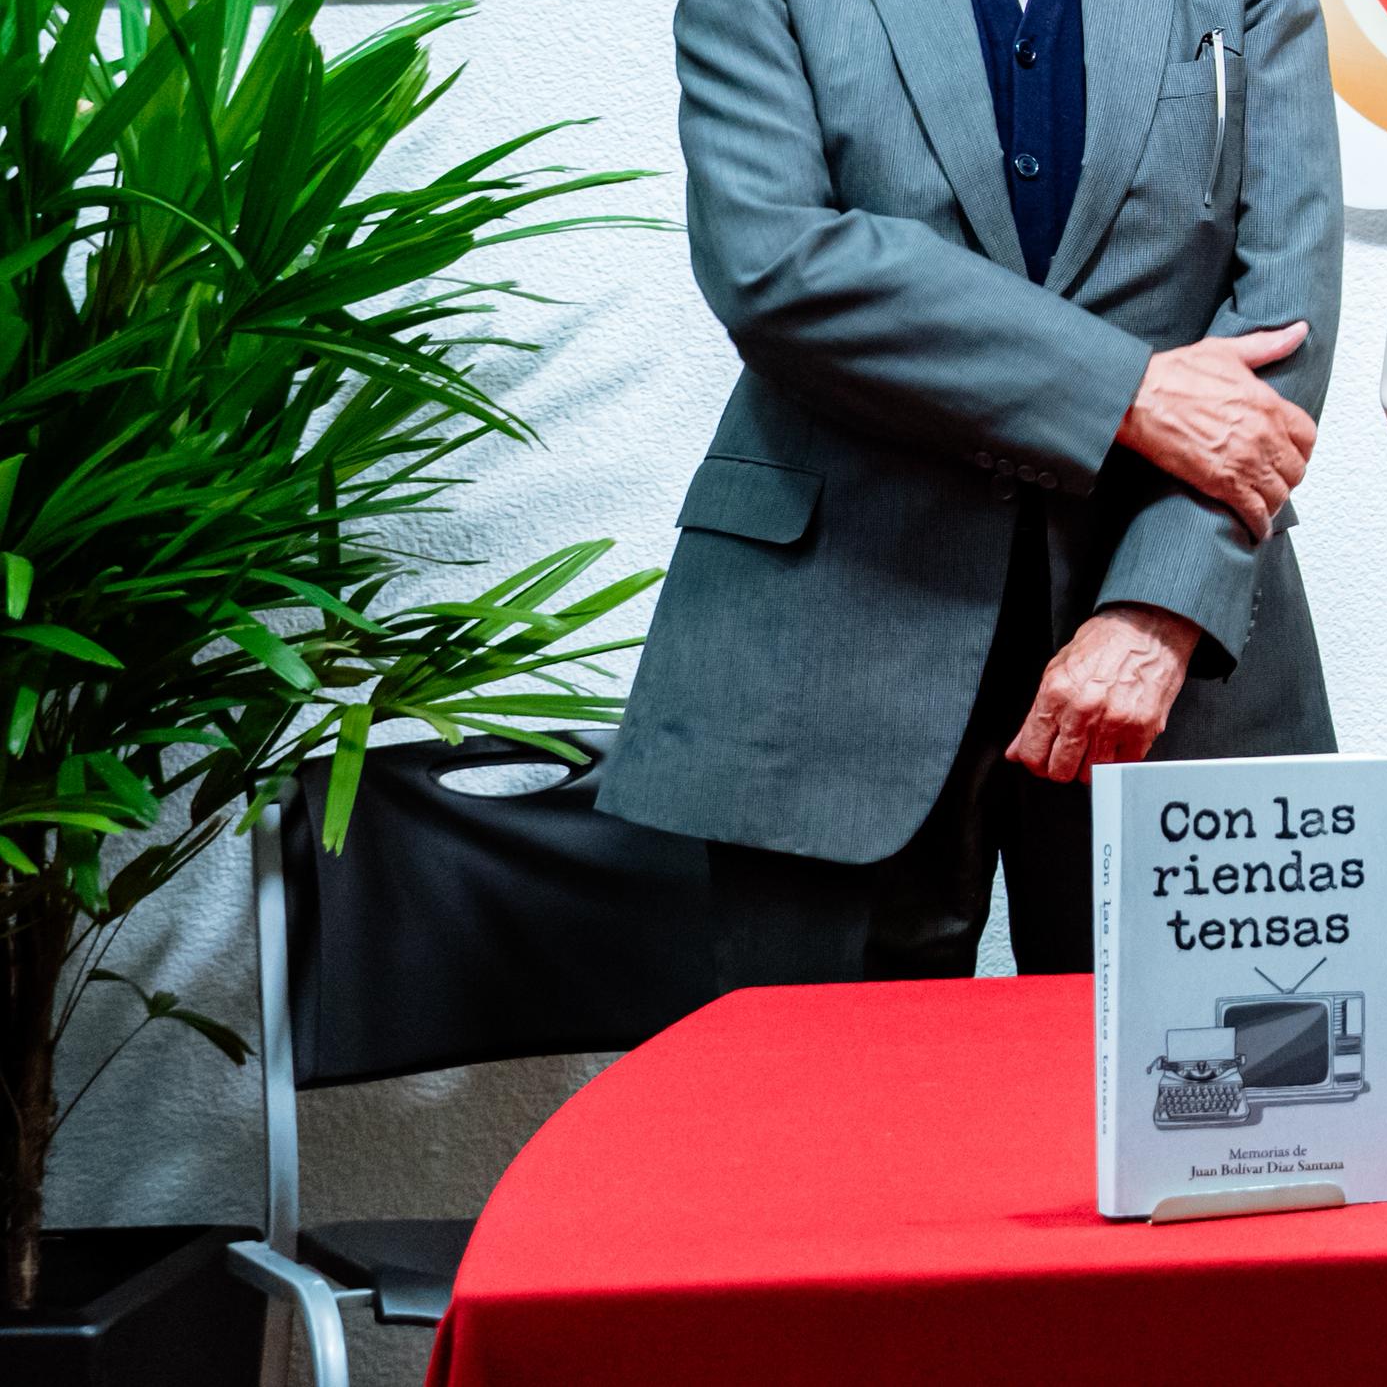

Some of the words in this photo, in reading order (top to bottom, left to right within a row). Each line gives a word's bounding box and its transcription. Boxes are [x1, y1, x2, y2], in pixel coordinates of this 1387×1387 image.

[1159, 800, 1258, 843] Con
[1273, 796, 1356, 841] las
[1103, 843, 1112, 886] Con
[1152, 850, 1365, 898] riendas
[1103, 899, 1111, 935] las
[1166, 909, 1351, 952] tensas
[1189, 1165, 1218, 1181] Juan
[1297, 1159, 1345, 1172] Santana
[1229, 1148, 1290, 1160] Memorias
[1292, 1144, 1308, 1156] de
